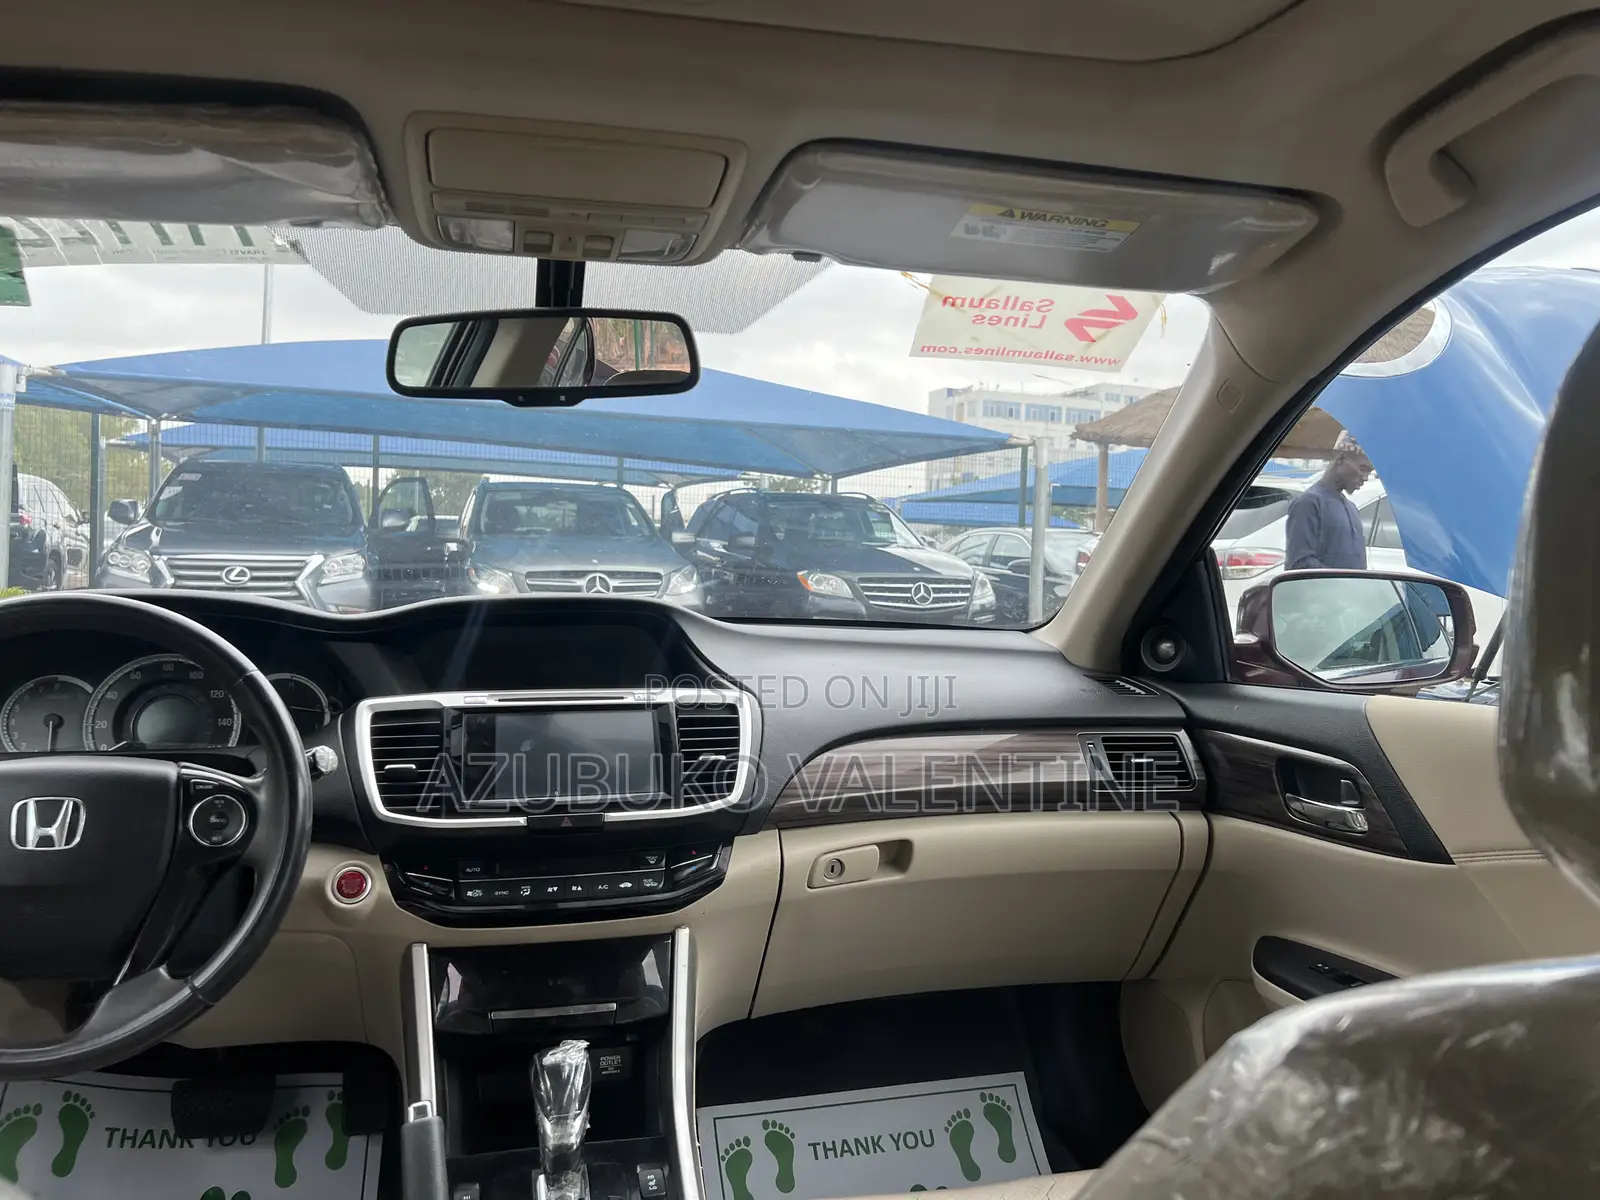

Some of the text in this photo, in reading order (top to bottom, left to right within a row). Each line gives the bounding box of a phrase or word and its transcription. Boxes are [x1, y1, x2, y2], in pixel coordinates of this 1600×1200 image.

[1020, 210, 1109, 228] WARNING
[131, 672, 142, 680] 60
[106, 691, 118, 699] 40
[210, 690, 225, 698] 120
[95, 720, 108, 729] 20
[217, 718, 232, 727] 140
[808, 1129, 935, 1160] THANK YOU
